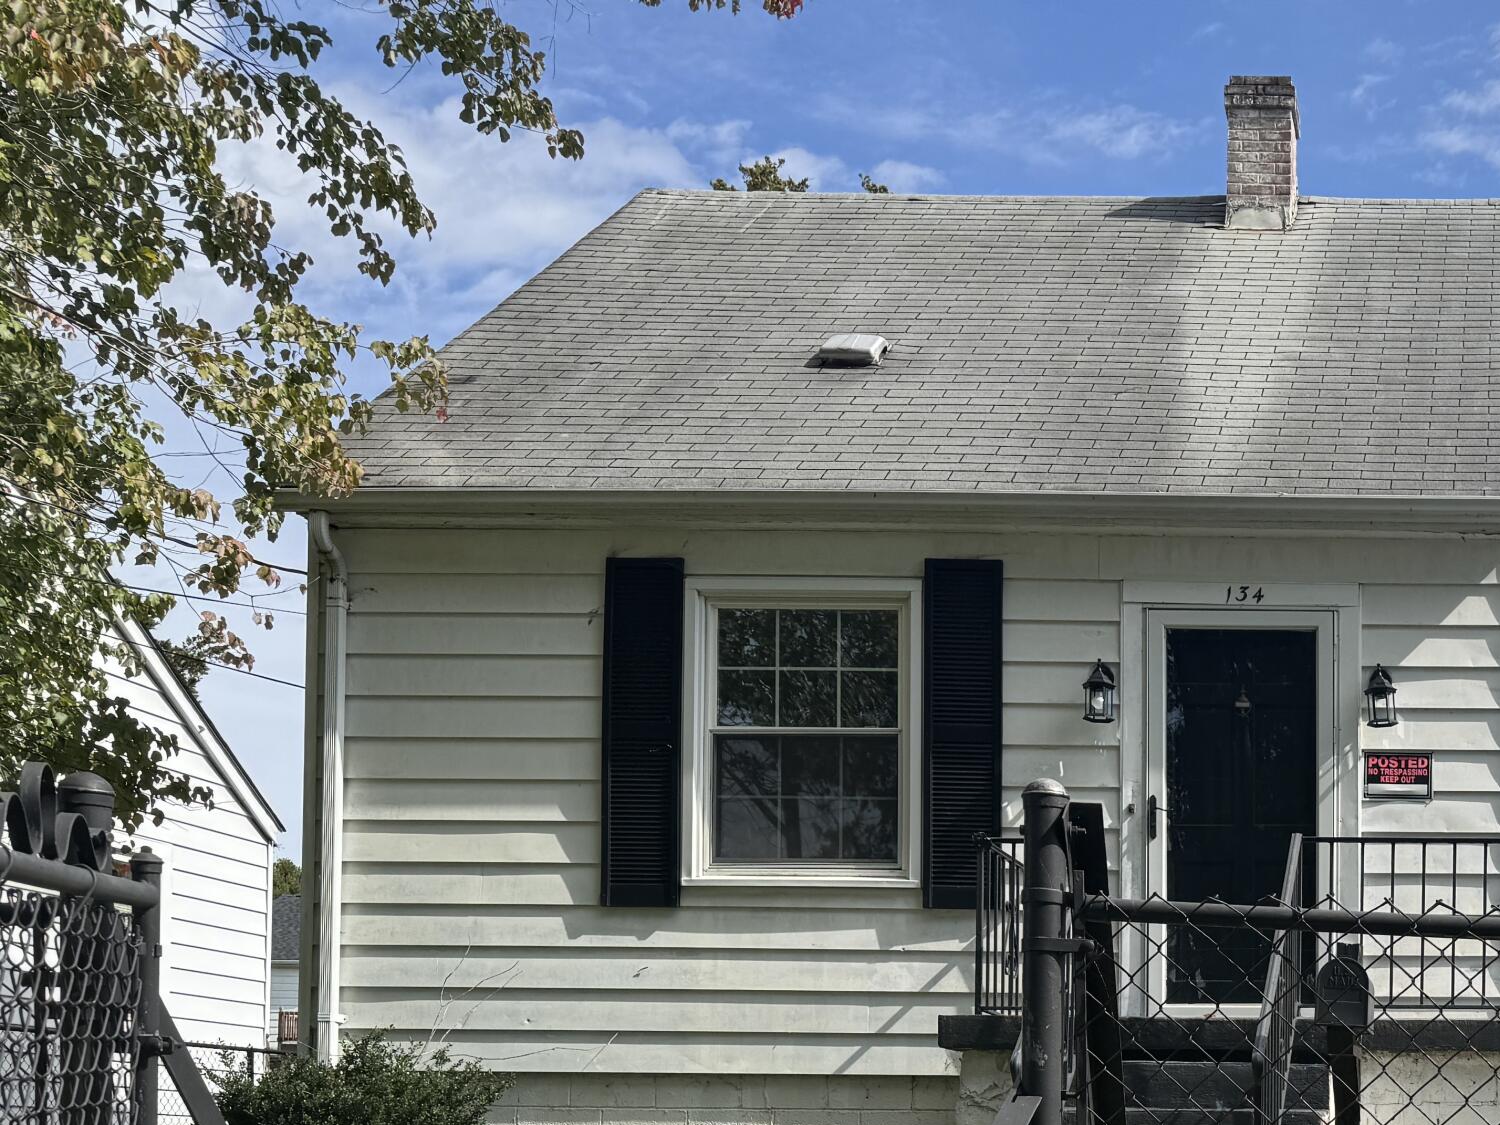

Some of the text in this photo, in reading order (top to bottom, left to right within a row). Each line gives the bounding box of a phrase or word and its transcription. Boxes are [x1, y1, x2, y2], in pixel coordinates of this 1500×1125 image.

[1226, 585, 1264, 604] 134
[1368, 756, 1428, 768] POSTED
[1381, 768, 1428, 776] TRESPASSING
